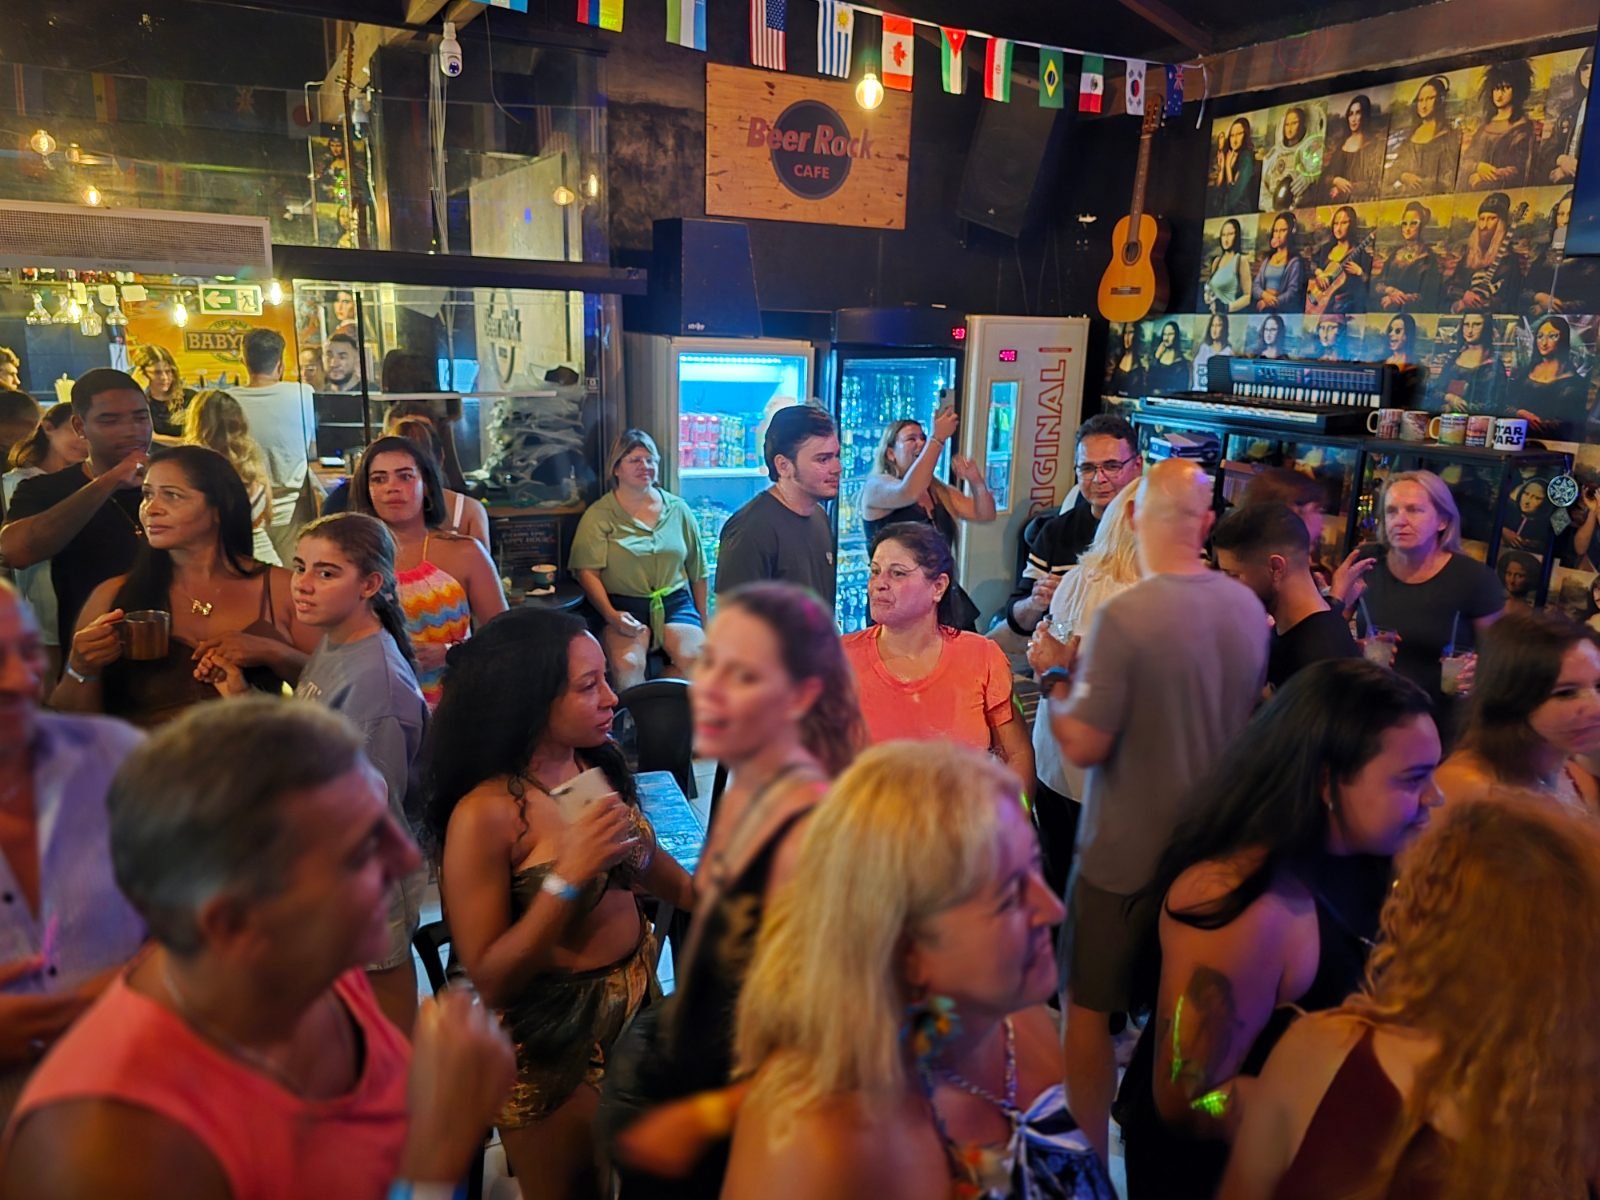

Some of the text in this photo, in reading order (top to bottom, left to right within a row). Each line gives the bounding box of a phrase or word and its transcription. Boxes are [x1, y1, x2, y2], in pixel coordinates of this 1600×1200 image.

[746, 116, 873, 159] Beer Rock
[793, 164, 831, 179] CAFE
[187, 332, 244, 350] BABY
[1028, 359, 1066, 518] RIGINAL
[1495, 425, 1524, 436] TAR
[1494, 436, 1523, 446] ARS
